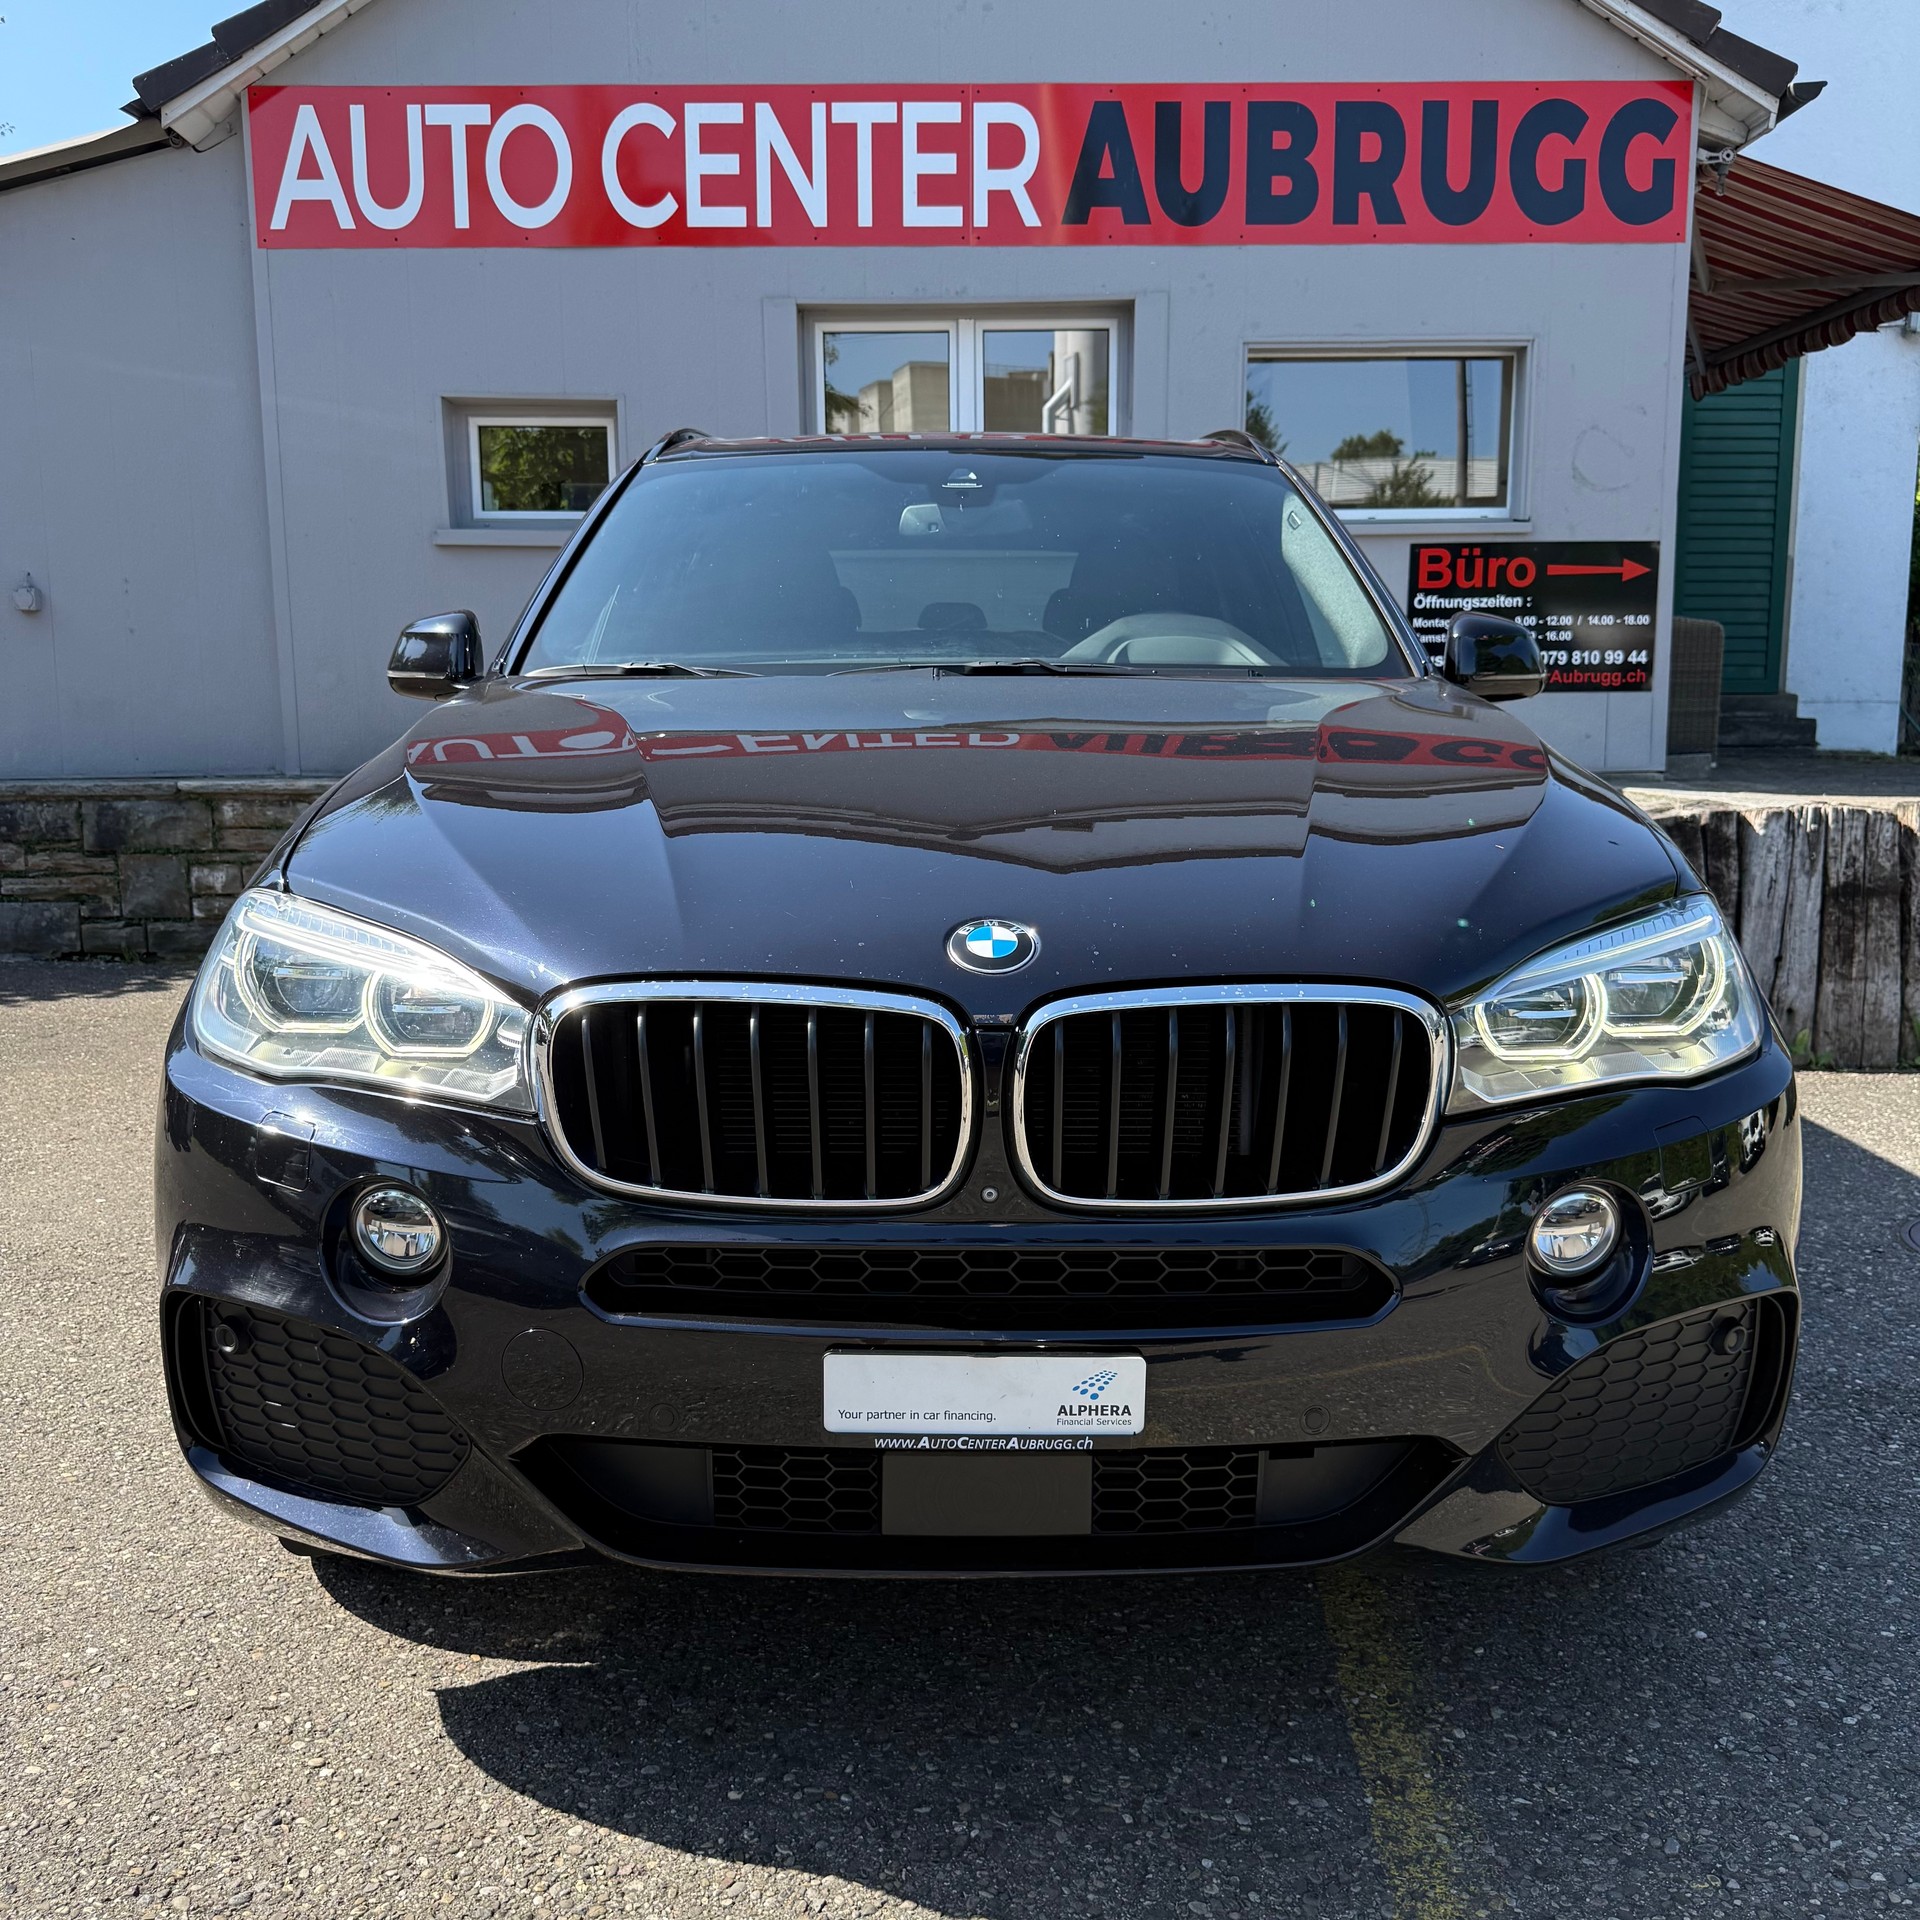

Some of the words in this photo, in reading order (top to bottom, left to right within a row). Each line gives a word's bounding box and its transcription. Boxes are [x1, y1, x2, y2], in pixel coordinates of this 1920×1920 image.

[270, 103, 573, 231] AUTO
[602, 101, 1041, 229] CENTER
[1063, 98, 1678, 227] AUBRUGG
[1418, 548, 1536, 589] Büro
[1413, 592, 1523, 611] Öffnungszeiten
[1545, 615, 1573, 626] 12.00
[1587, 614, 1615, 626] 14.00
[1622, 614, 1650, 626] 18.00
[1544, 630, 1573, 641] 16.00
[1571, 649, 1601, 665] 810
[1604, 649, 1625, 665] 99
[1626, 649, 1648, 665] 44
[1547, 668, 1647, 687] Aubrugg.ch
[838, 1409, 863, 1419] Your
[866, 1409, 906, 1422] partner
[909, 1409, 920, 1420] in
[923, 1411, 940, 1421] car
[943, 1410, 997, 1423] financing.
[1057, 1404, 1132, 1417] ALPHERA
[1056, 1417, 1094, 1426] Financial
[1096, 1417, 1132, 1426] Services
